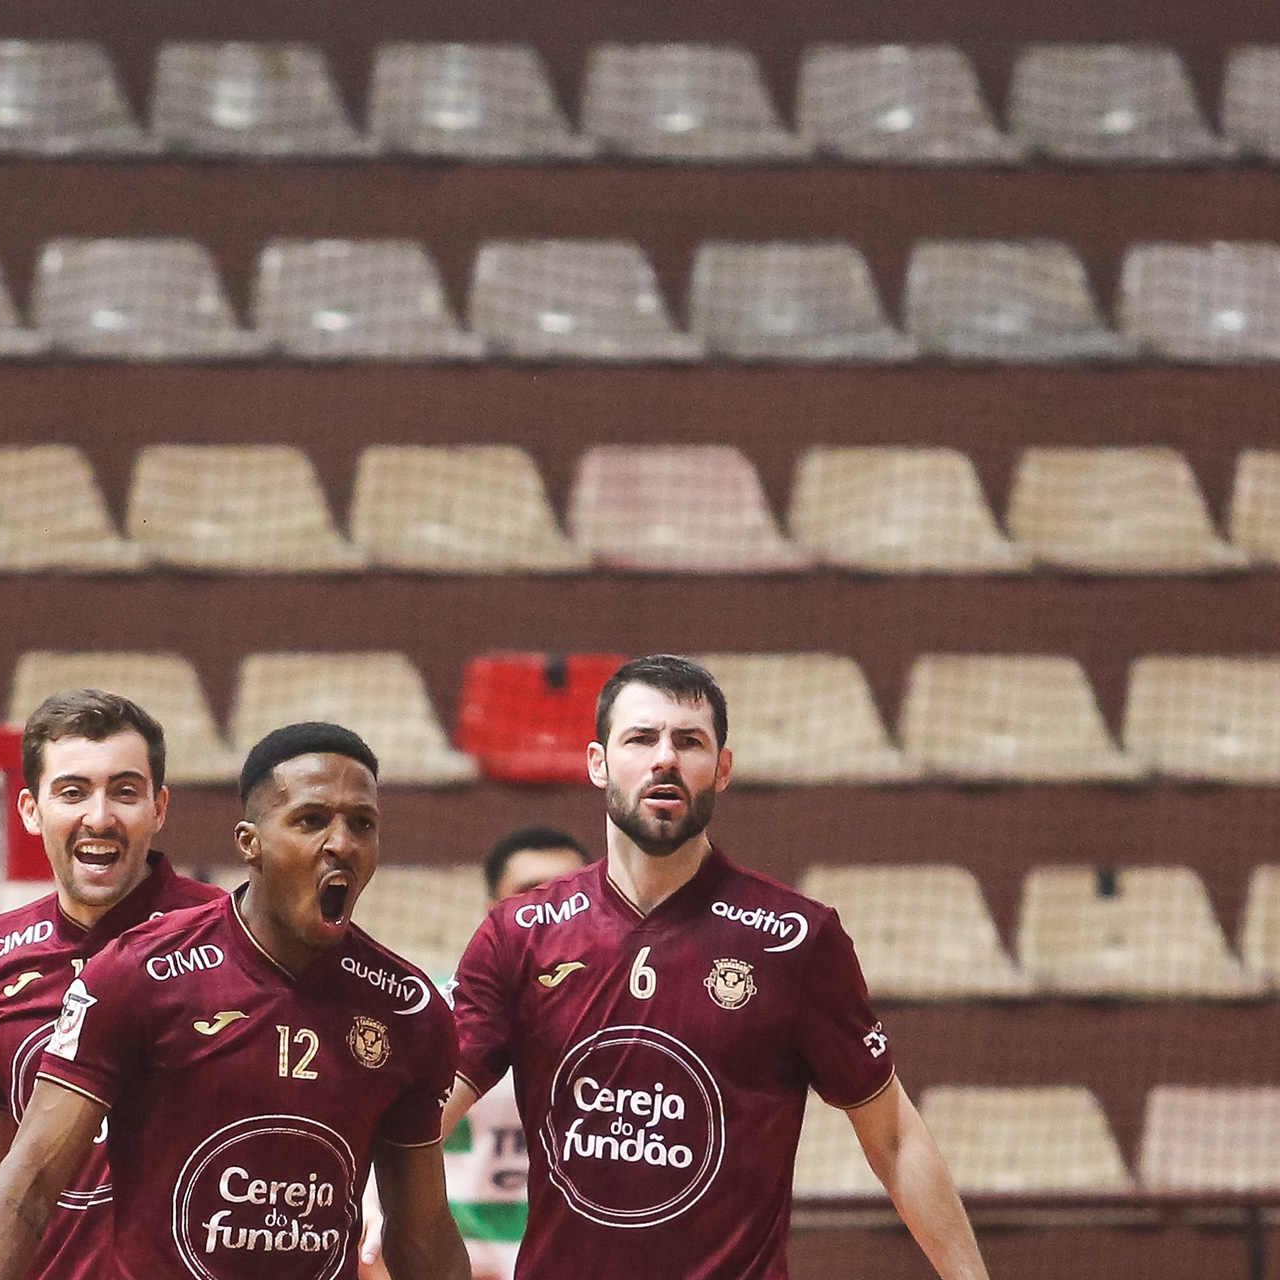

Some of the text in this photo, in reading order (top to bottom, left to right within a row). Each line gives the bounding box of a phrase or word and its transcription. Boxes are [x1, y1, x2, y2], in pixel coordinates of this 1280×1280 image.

[515, 892, 591, 928] CIMD
[711, 901, 797, 941] auditiv
[146, 944, 224, 981] CIMD
[340, 957, 417, 1002] auditiv
[629, 946, 657, 999] 6
[276, 1025, 320, 1080] 12
[573, 1076, 686, 1126] Cereja
[563, 1119, 693, 1169] fundão
[610, 1117, 633, 1136] do
[219, 1166, 334, 1217] Cereja
[202, 1210, 340, 1253] fundão
[265, 1208, 288, 1227] do
